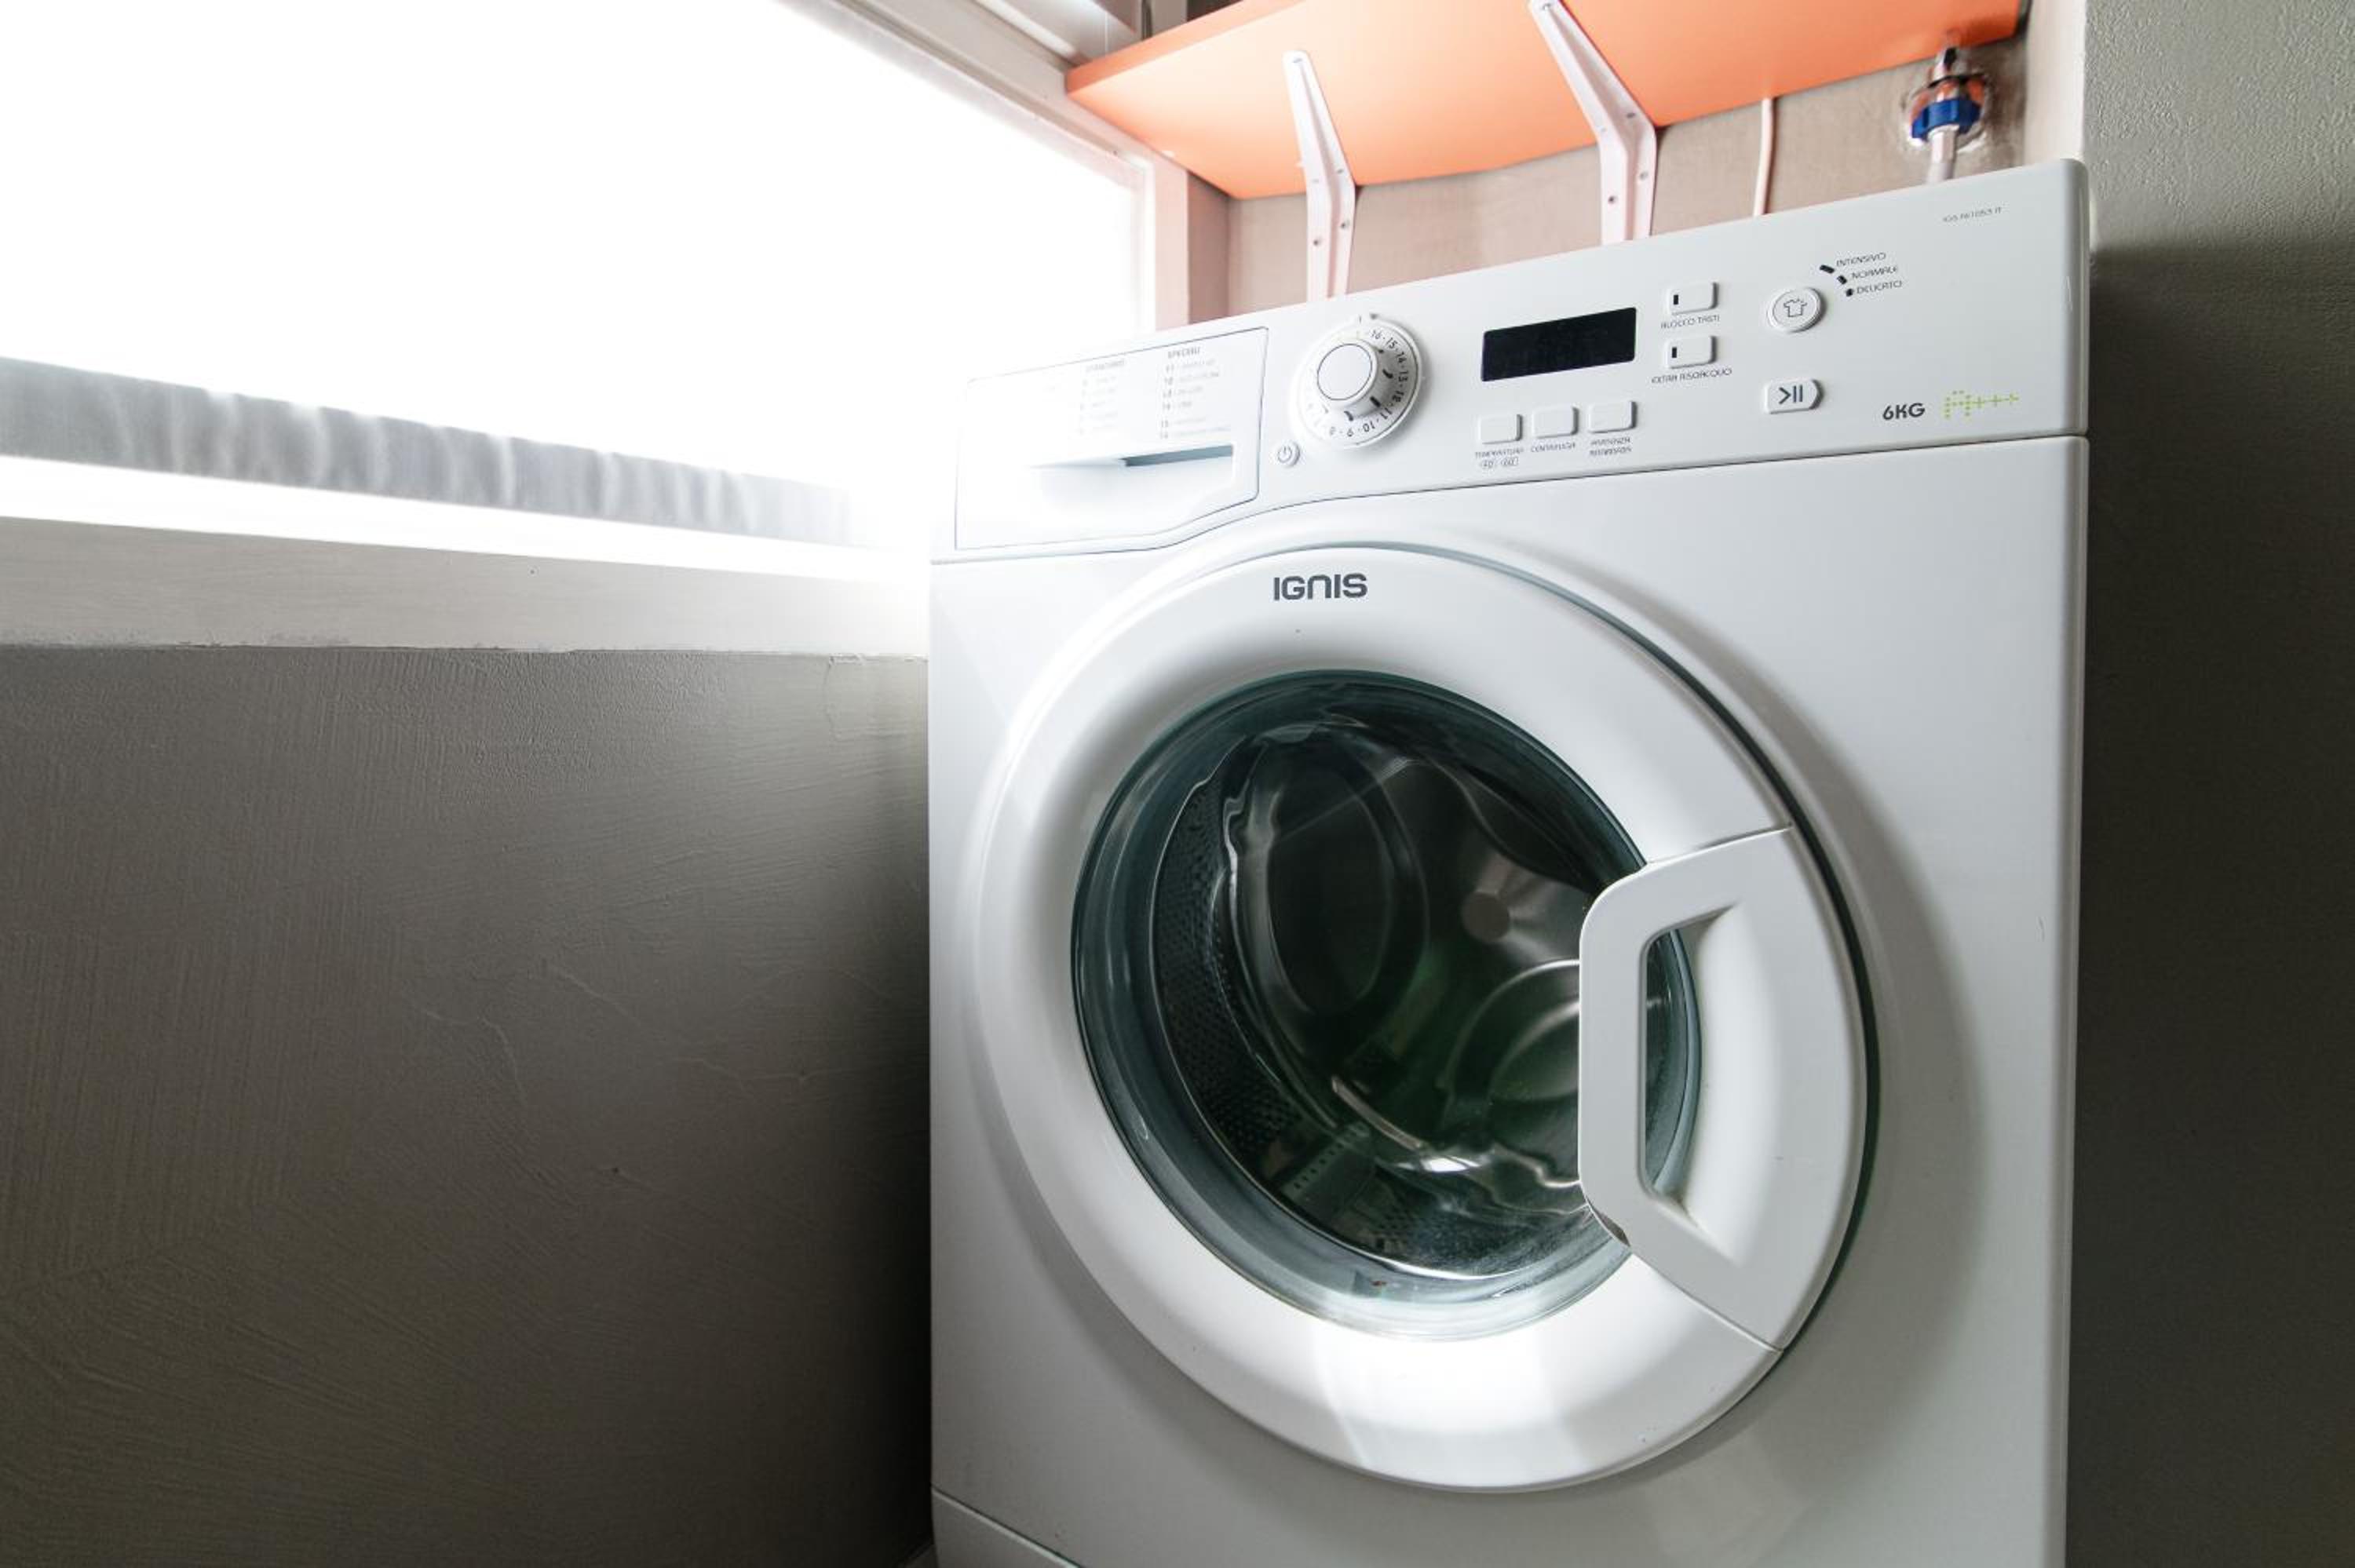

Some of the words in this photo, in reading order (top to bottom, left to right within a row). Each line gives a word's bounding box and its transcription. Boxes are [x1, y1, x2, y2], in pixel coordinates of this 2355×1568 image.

[1836, 252, 1887, 267] INTENSIVO
[1852, 265, 1897, 279] NORMALE
[1857, 280, 1903, 294] DELICATO
[1698, 314, 1720, 324] TASTI
[1386, 337, 1399, 349] 15
[1396, 352, 1408, 363] 14
[1398, 370, 1409, 383] 13
[1651, 374, 1678, 384] EXTRA
[1379, 407, 1393, 420] 11
[1882, 403, 1926, 421] 6KG
[1361, 421, 1376, 433] 10
[1273, 573, 1368, 601] IGNIS
